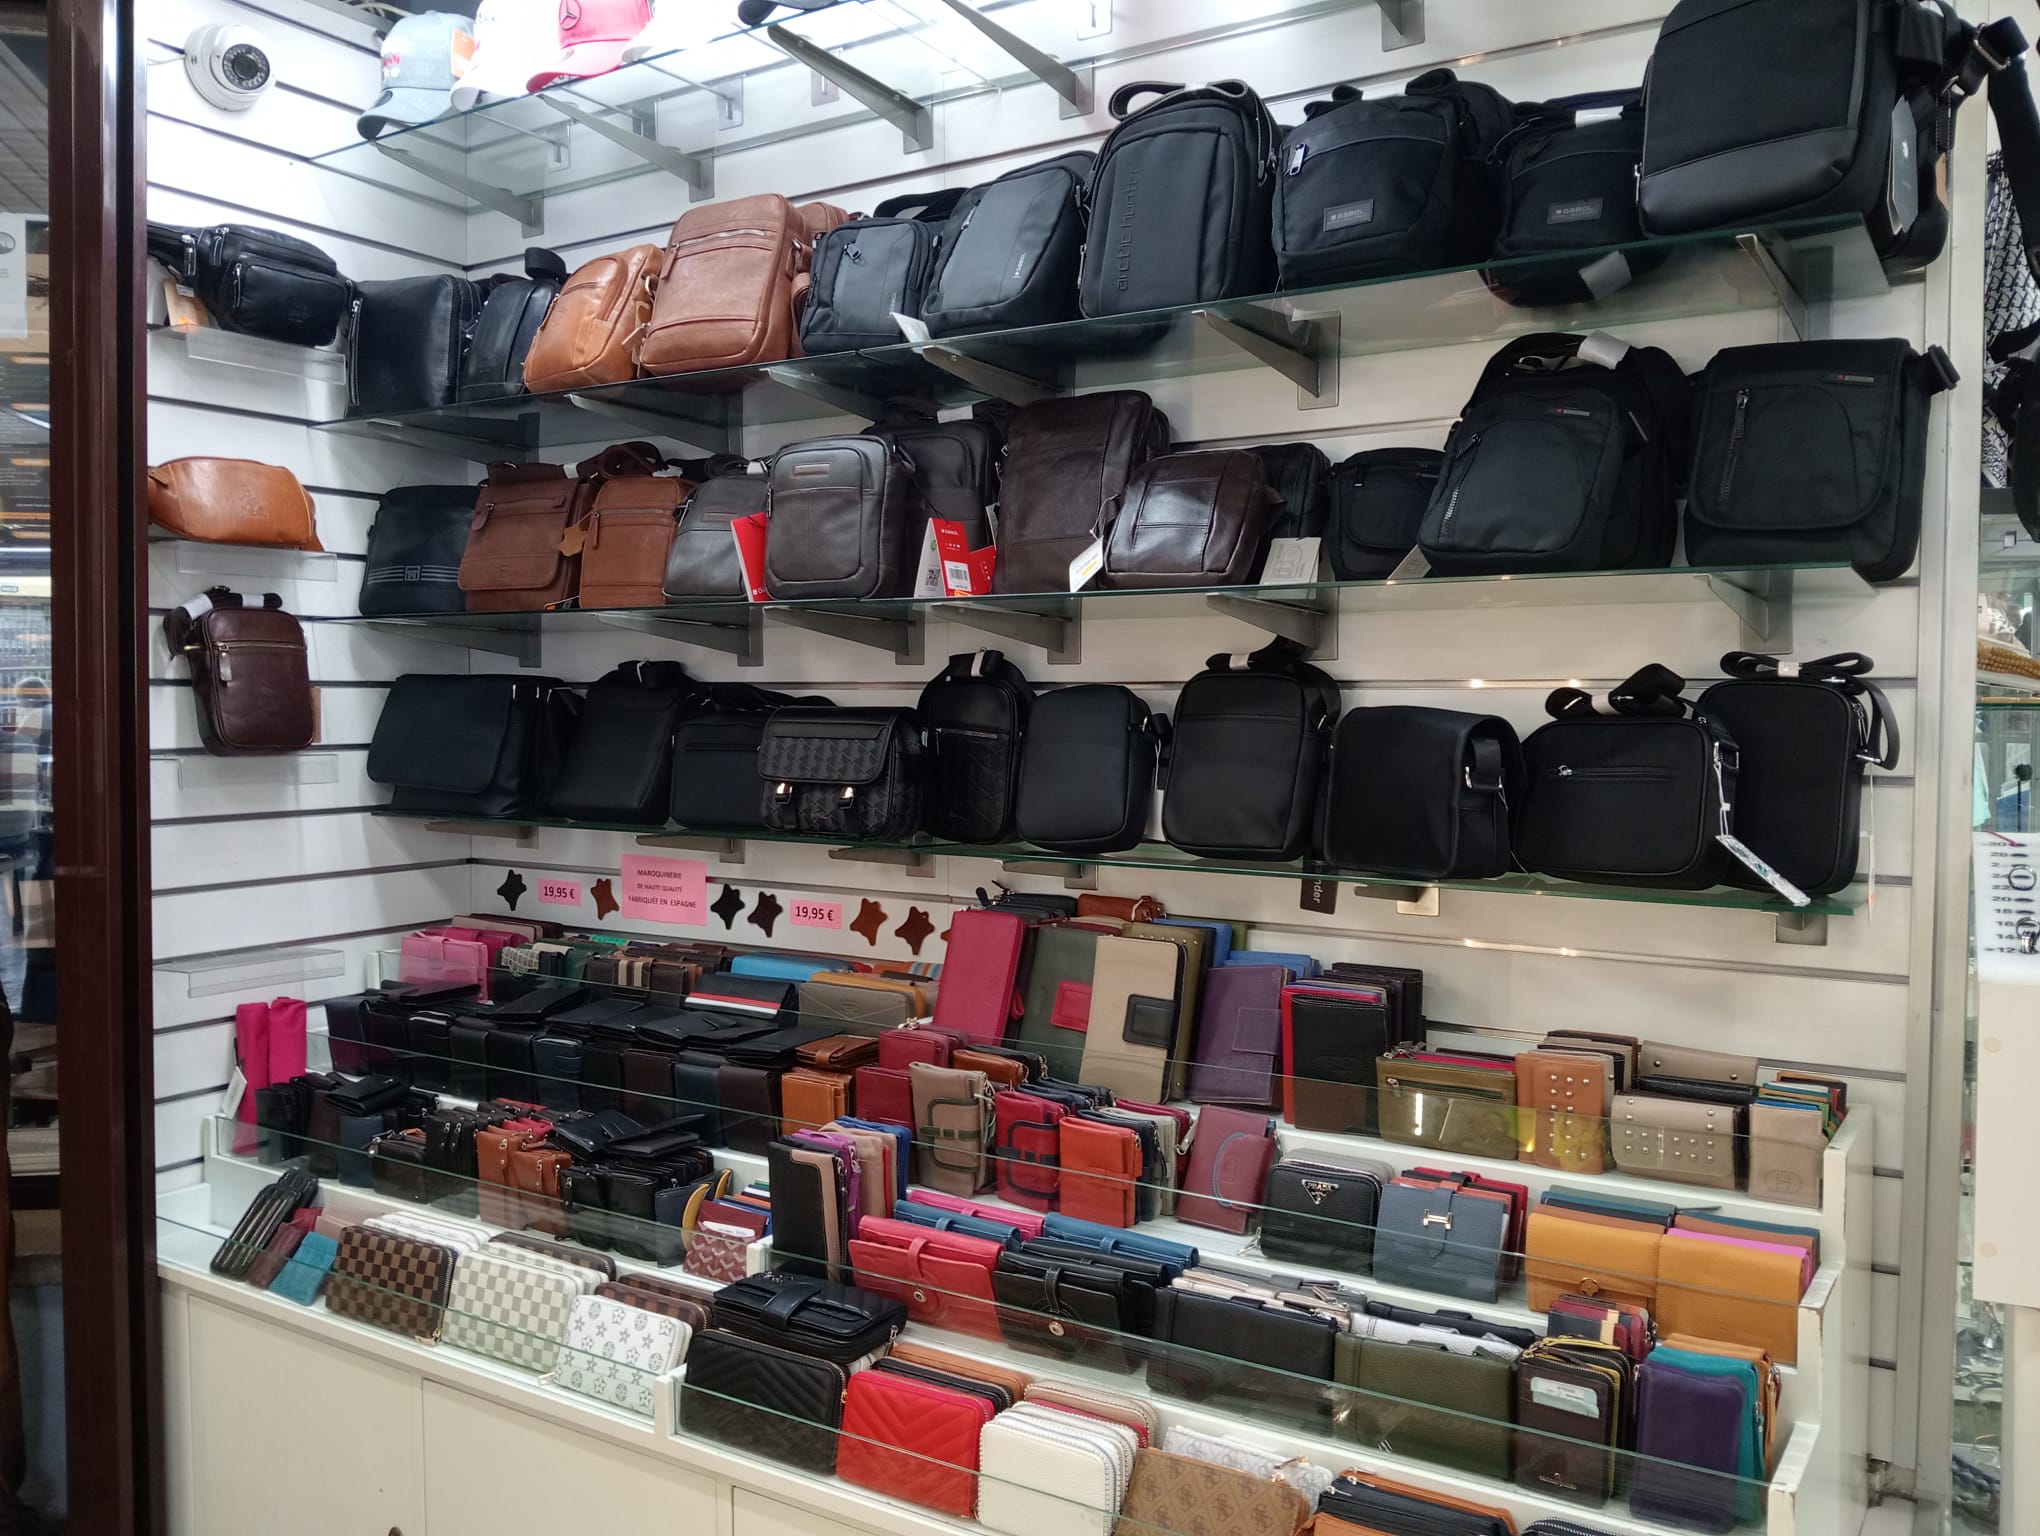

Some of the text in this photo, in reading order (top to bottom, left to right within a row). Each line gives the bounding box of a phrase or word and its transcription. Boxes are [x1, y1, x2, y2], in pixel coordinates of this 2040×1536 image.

[637, 869, 682, 879] MAROQUINERIE
[544, 886, 576, 899] 19,95 €
[628, 895, 658, 904] FABRIQUÉE
[670, 899, 697, 908] ESPAGNE
[795, 906, 834, 921] 19,95 €
